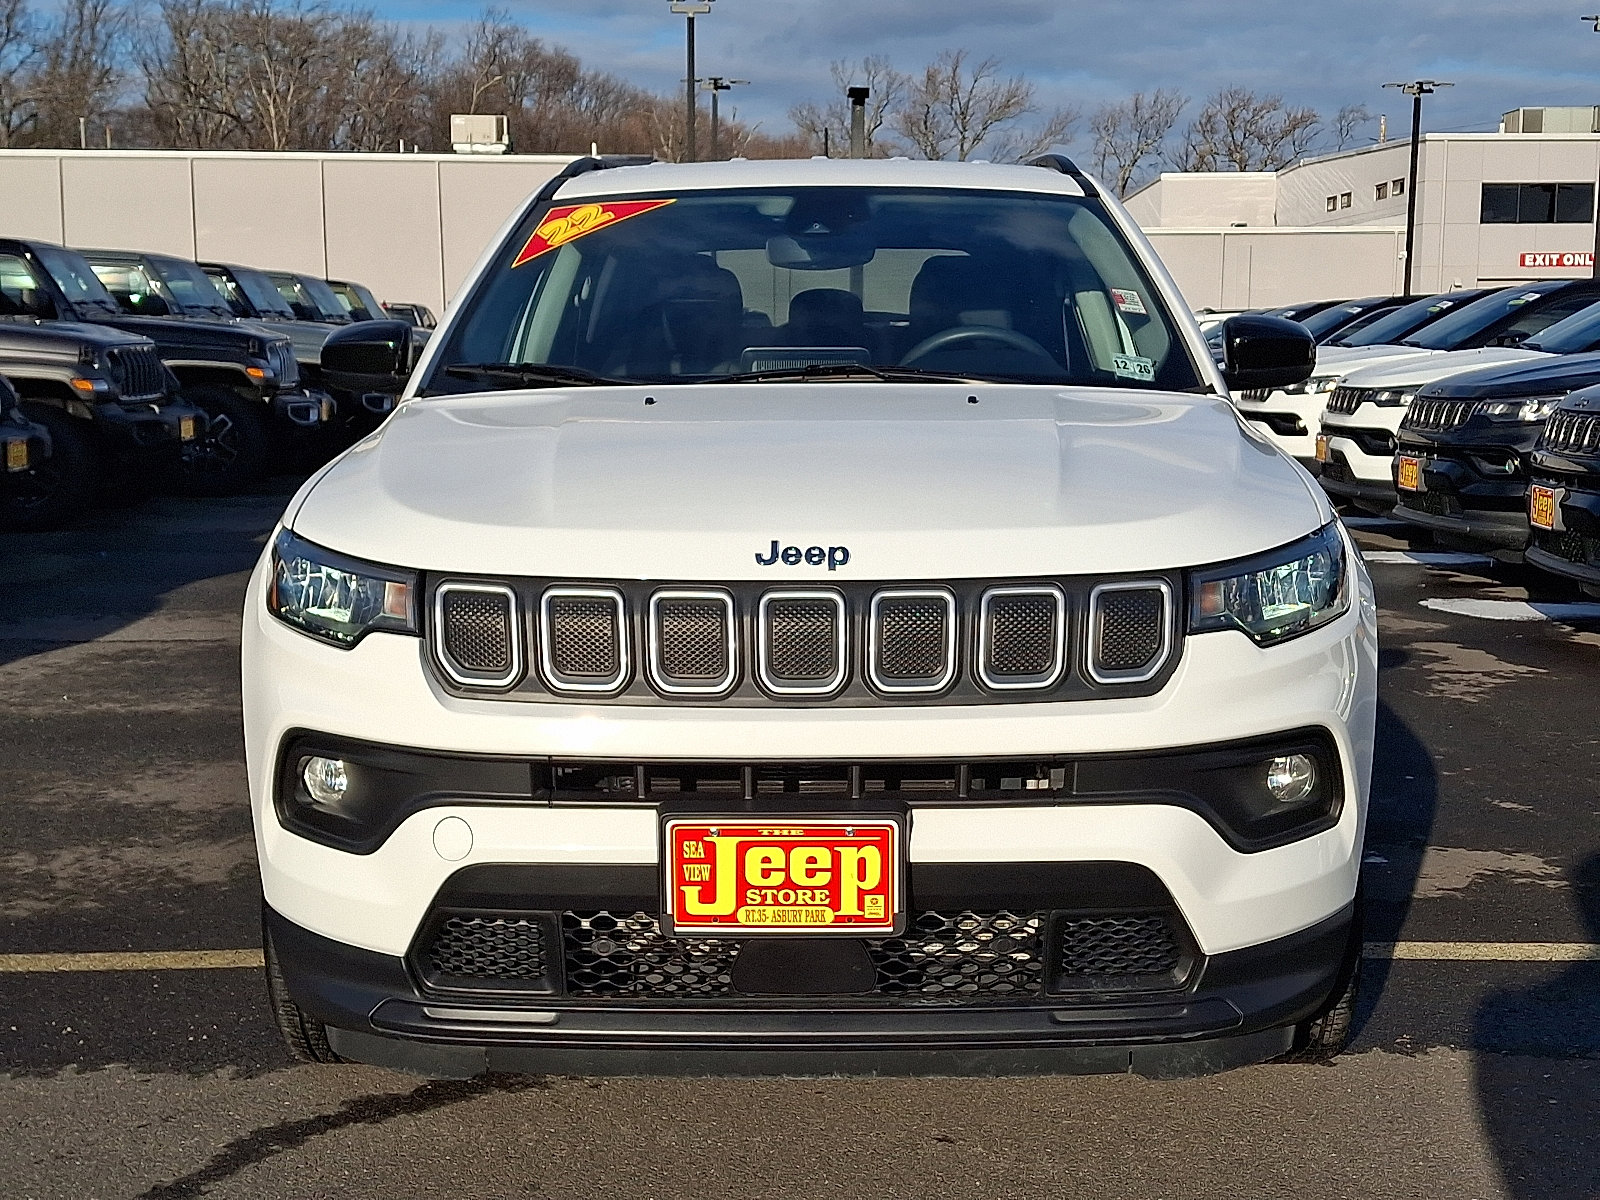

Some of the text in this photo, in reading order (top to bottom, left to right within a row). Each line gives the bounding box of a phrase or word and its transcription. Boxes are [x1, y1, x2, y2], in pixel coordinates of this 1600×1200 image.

[536, 204, 616, 246] 22
[1525, 253, 1594, 266] EXIT ONL
[1114, 360, 1129, 370] 12
[755, 540, 851, 571] Jeep
[683, 841, 705, 859] SEA
[680, 836, 882, 916] Jeep
[683, 864, 711, 882] VIEW
[745, 889, 830, 905] STORE
[771, 909, 803, 923] ASBURY
[805, 909, 826, 923] PARK
